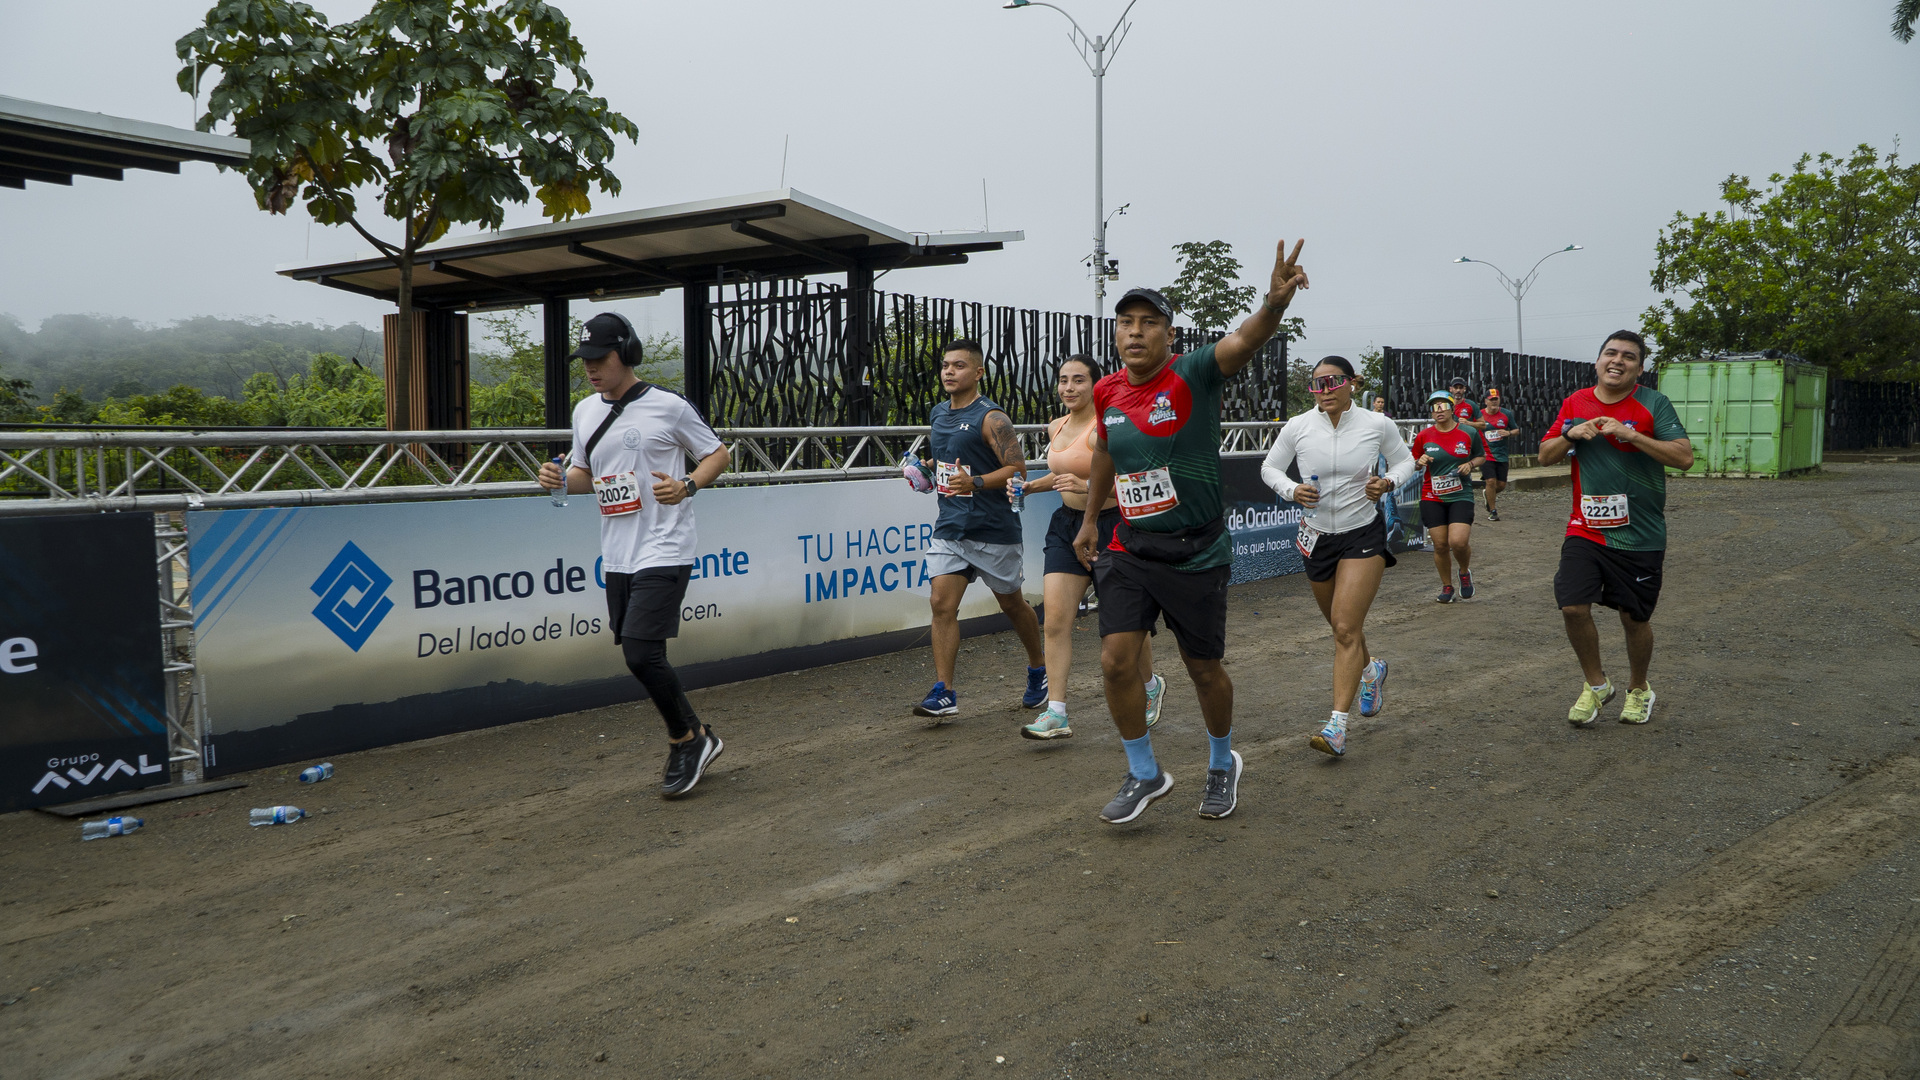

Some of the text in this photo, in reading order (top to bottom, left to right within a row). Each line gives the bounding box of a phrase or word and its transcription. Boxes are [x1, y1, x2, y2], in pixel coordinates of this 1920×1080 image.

[580, 326, 592, 342] LA
[599, 485, 631, 503] 2002
[1125, 482, 1164, 504] 1874
[1435, 479, 1456, 489] 2227
[1228, 505, 1301, 531] de Occidente
[1586, 505, 1618, 517] 2221
[797, 523, 933, 564] TU HACER
[1236, 541, 1249, 556] los
[1249, 542, 1265, 557] que
[1266, 537, 1292, 552] hacen.
[1407, 536, 1424, 547] AVAL
[412, 569, 535, 610] Banco
[543, 557, 586, 595] de
[805, 558, 932, 604] IMPACTA
[417, 628, 462, 659] Del
[470, 621, 527, 651] lado
[532, 616, 562, 642] de
[569, 613, 601, 638] los
[47, 752, 100, 769] Grupo
[31, 754, 163, 795] AVAL
